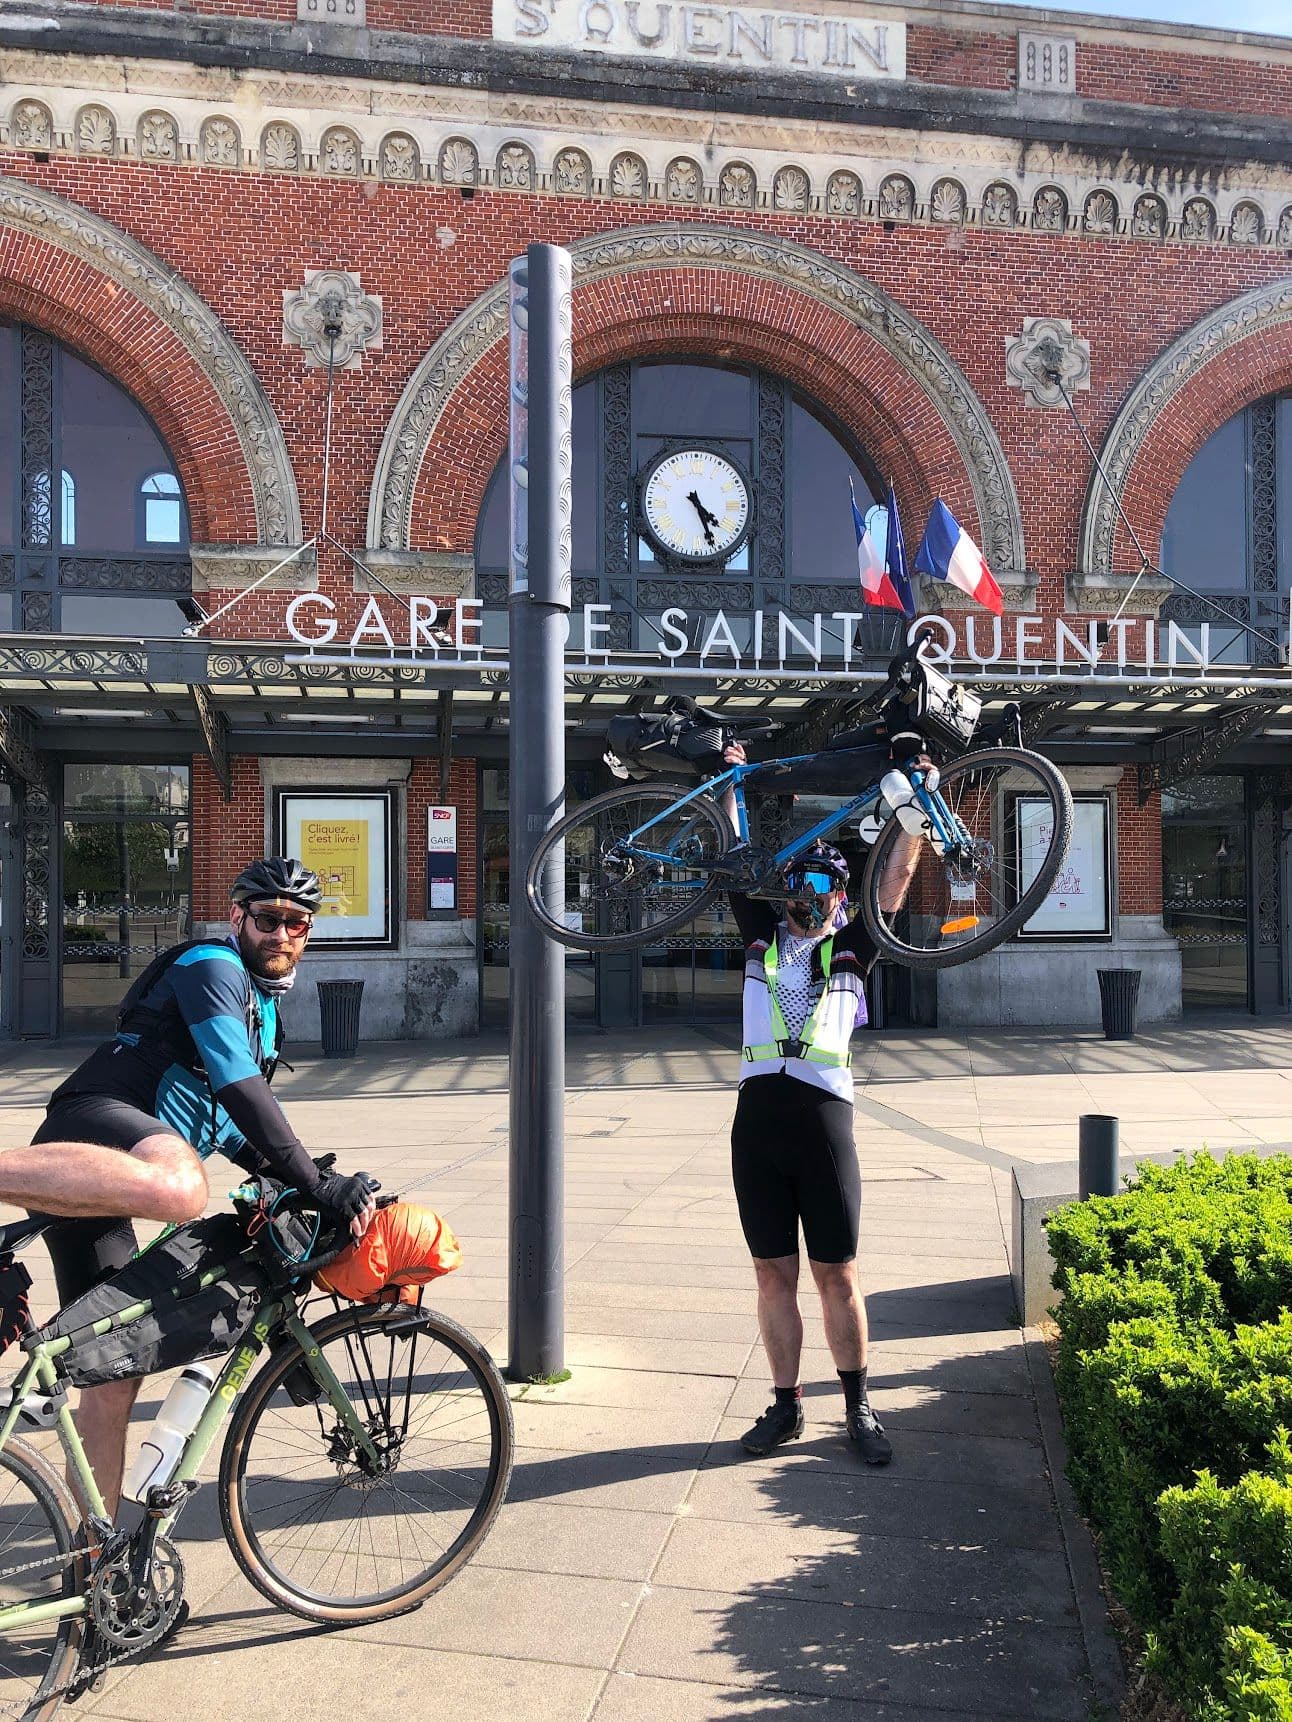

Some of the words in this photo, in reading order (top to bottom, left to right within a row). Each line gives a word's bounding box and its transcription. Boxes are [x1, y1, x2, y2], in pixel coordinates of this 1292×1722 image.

[576, 0, 889, 71] QUENTIN
[285, 593, 484, 651] GARE
[657, 607, 864, 663] SAINT
[907, 614, 1210, 670] QUENTIN
[308, 823, 349, 835] Cliquez,
[308, 834, 332, 843] c'est
[430, 836, 454, 845] GARE
